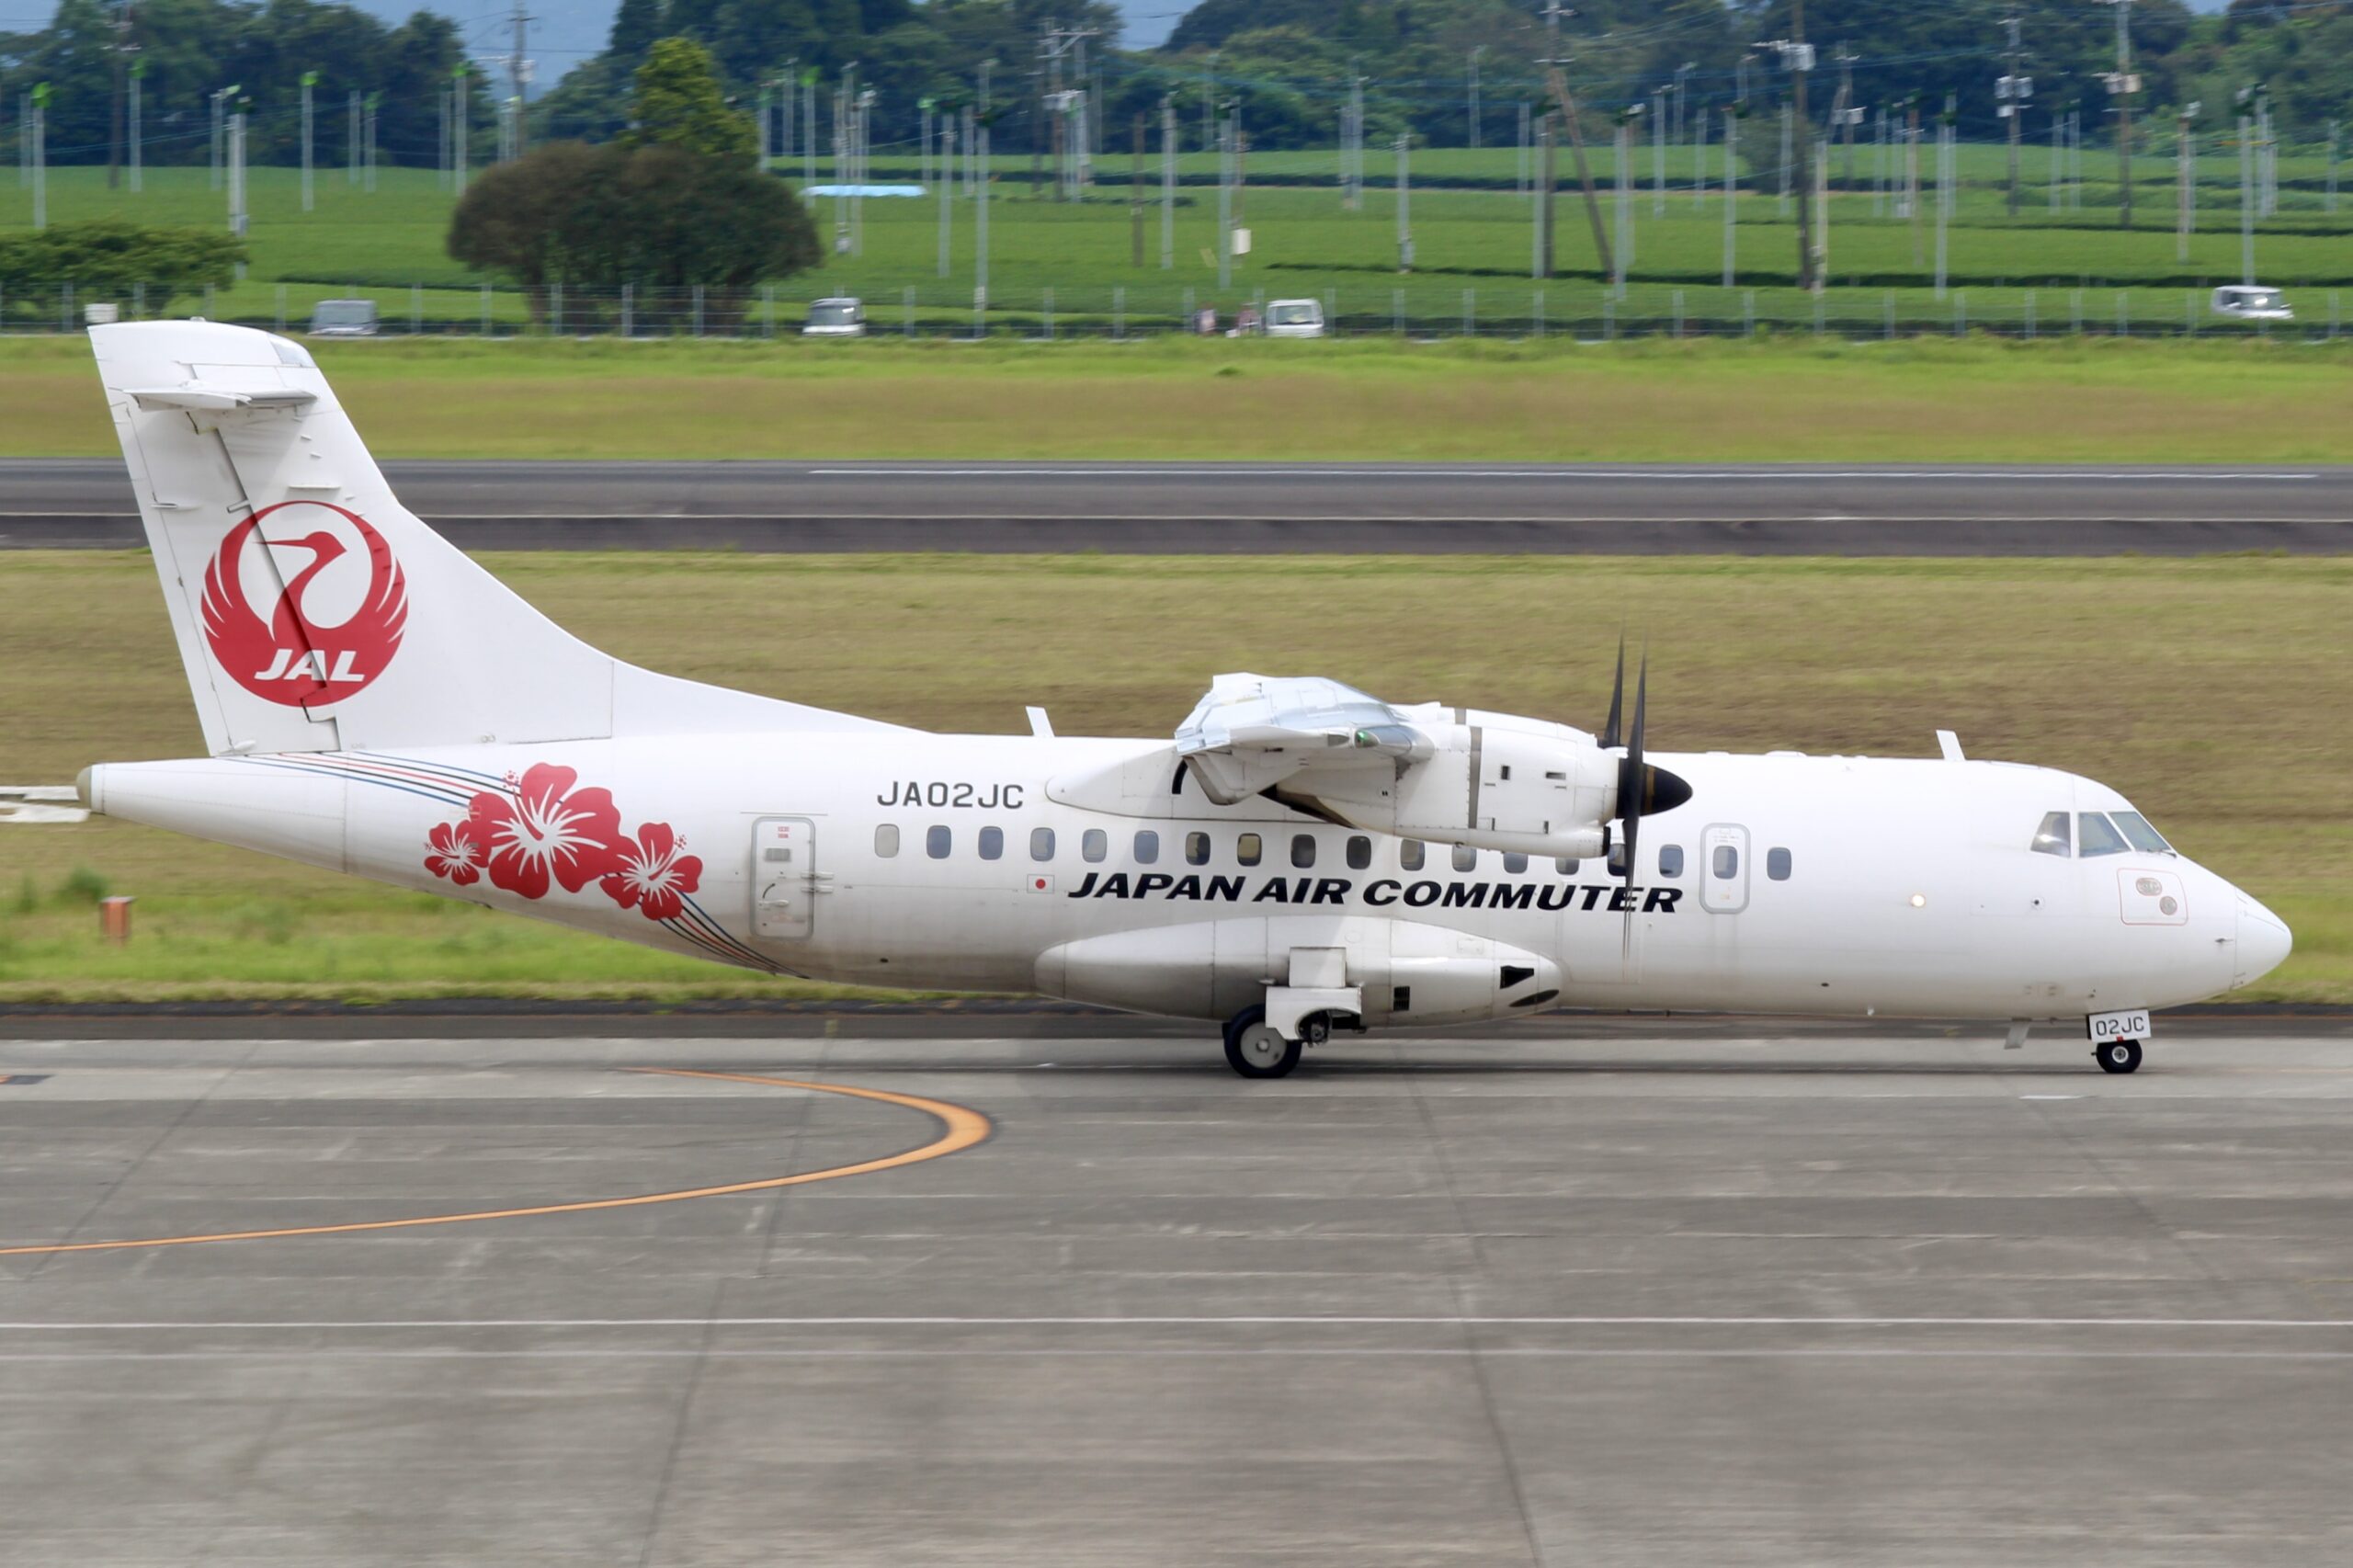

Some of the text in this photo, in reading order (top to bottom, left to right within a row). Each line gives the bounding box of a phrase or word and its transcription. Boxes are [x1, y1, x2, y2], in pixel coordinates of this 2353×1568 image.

[254, 648, 366, 682] JAL
[877, 781, 1024, 810] JA02JC
[1067, 872, 1683, 914] JAPAN AIR COMMUTER
[2096, 1016, 2144, 1036] 02JC
